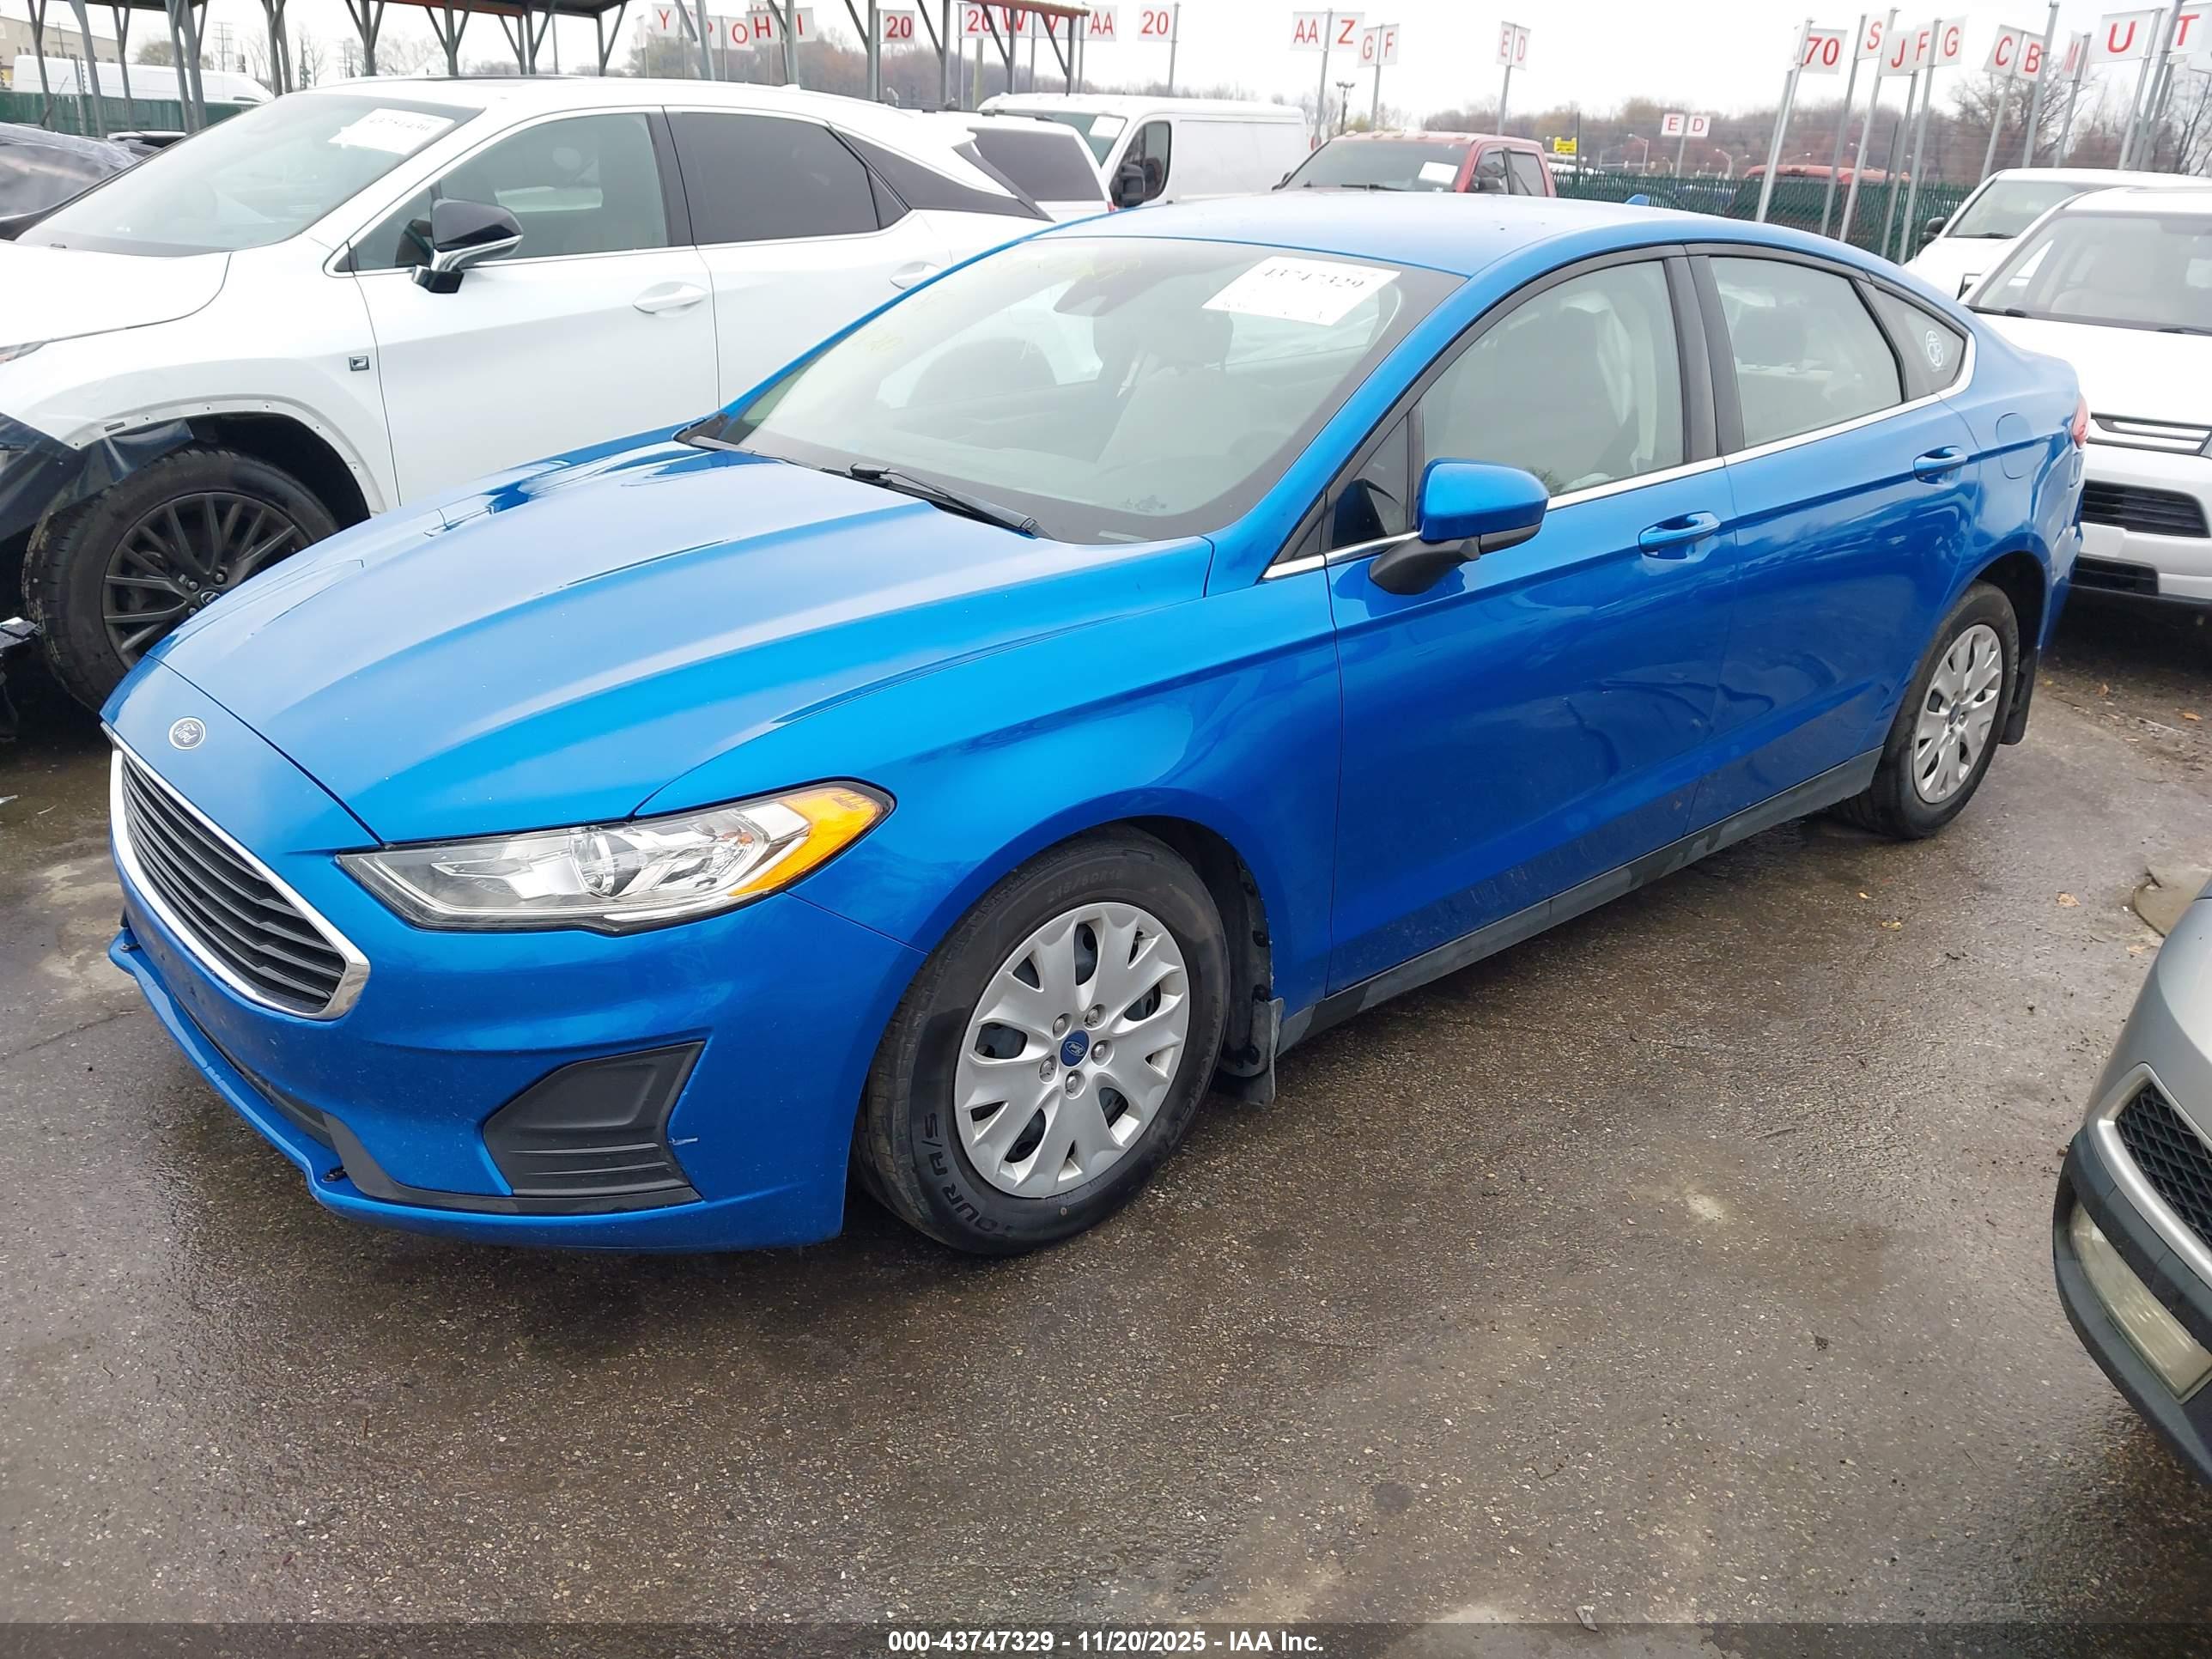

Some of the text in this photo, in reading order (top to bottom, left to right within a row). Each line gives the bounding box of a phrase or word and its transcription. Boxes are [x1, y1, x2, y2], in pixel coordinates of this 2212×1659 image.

[658, 9, 670, 30] Y
[754, 15, 771, 39] H
[886, 15, 912, 39] 20
[1090, 12, 1114, 35] AA
[1141, 11, 1169, 35] 20
[1293, 18, 1318, 44] AA
[1338, 19, 1356, 44] Z
[2177, 14, 2200, 46] T
[732, 23, 748, 44] O
[1363, 35, 1373, 59] G
[1384, 31, 1395, 58] F
[1501, 30, 1510, 57] E
[1867, 21, 1882, 50] S
[1916, 31, 1929, 61] F
[1944, 26, 1959, 57] G
[2107, 21, 2136, 53] U
[1517, 34, 1526, 61] D
[1805, 36, 1840, 66] 70
[1891, 39, 1905, 68] J
[1995, 35, 2013, 66] C
[2024, 42, 2041, 73] B
[1668, 117, 1679, 131] E
[1692, 118, 1705, 131] D
